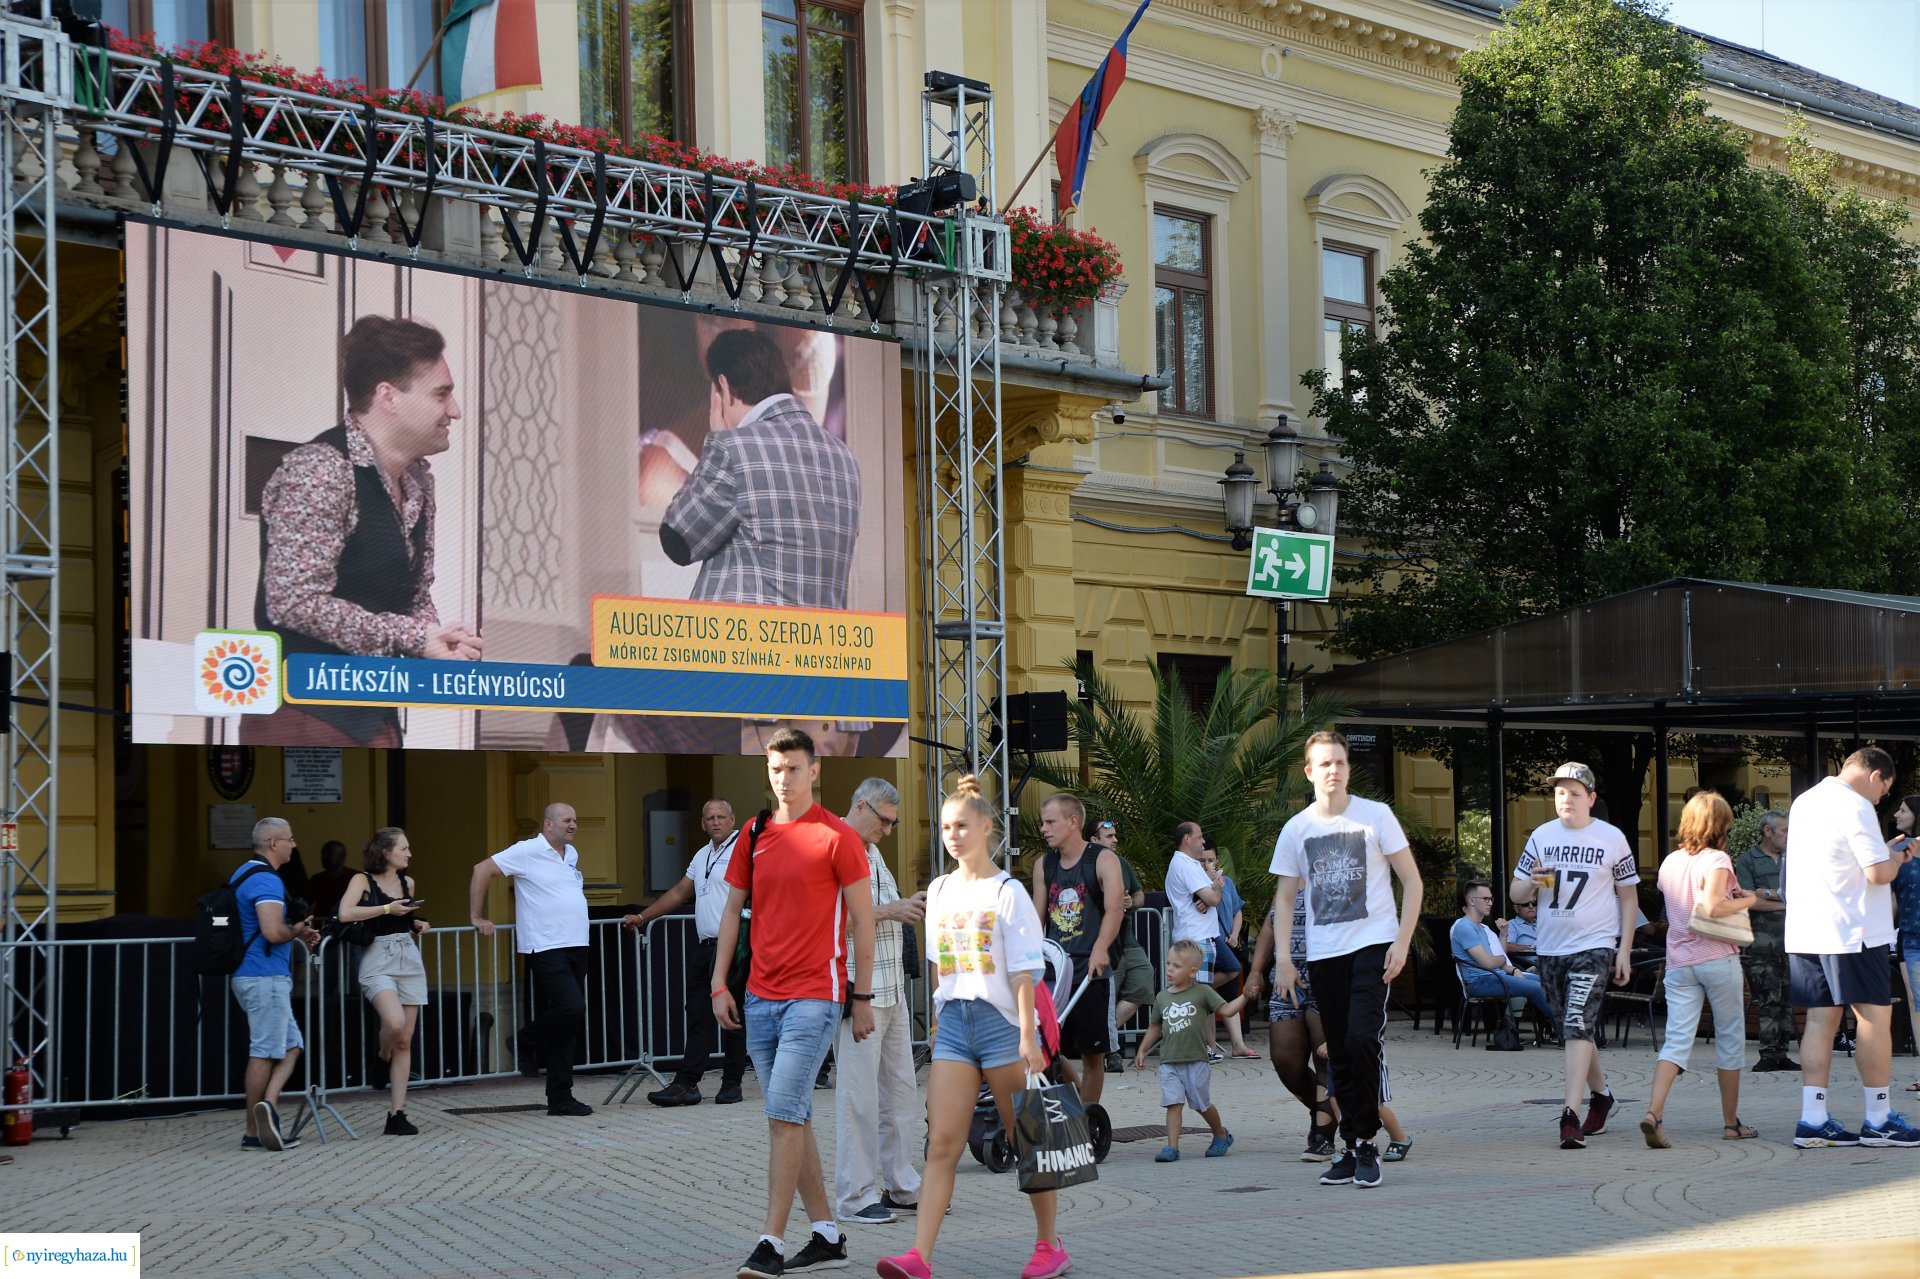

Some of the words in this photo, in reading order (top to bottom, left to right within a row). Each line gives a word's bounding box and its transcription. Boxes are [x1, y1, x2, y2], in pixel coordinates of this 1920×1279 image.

[610, 611, 719, 640] AUGUSZTUS
[725, 618, 753, 642] 26.
[759, 620, 823, 646] SZERDA
[828, 624, 874, 648] 19.30
[609, 641, 658, 661] MÓRICZ
[663, 647, 726, 665] ZSIGMOND
[732, 647, 781, 667] SZÍNHÁZ
[795, 653, 872, 671] NAGYSZÍNPAD
[306, 661, 409, 694] JÁTÉKSZÍN
[432, 668, 566, 699] LEGÉNYBÚCSÚ
[1313, 857, 1350, 875] GAME
[1544, 846, 1605, 866] WARRIOR
[1549, 869, 1590, 911] 17
[1564, 972, 1599, 1031] EVERLAST
